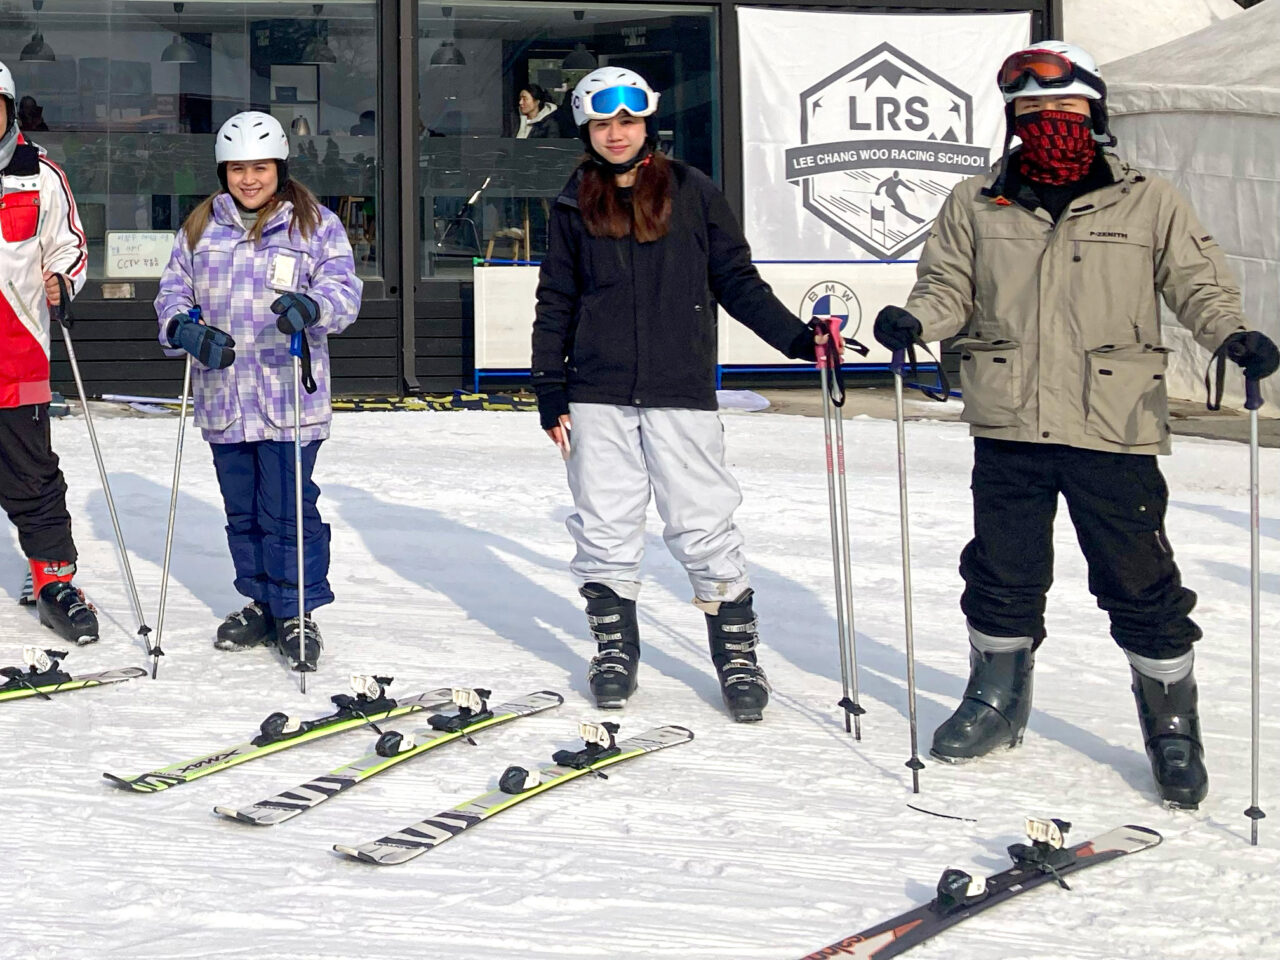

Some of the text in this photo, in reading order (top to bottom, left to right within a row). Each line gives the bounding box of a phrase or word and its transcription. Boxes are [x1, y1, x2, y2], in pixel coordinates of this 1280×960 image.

[849, 96, 930, 132] LRS
[793, 156, 815, 169] LEE
[817, 150, 858, 165] CHANG
[859, 149, 889, 160] WOO
[891, 149, 935, 162] RACING
[808, 284, 853, 302] BMW
